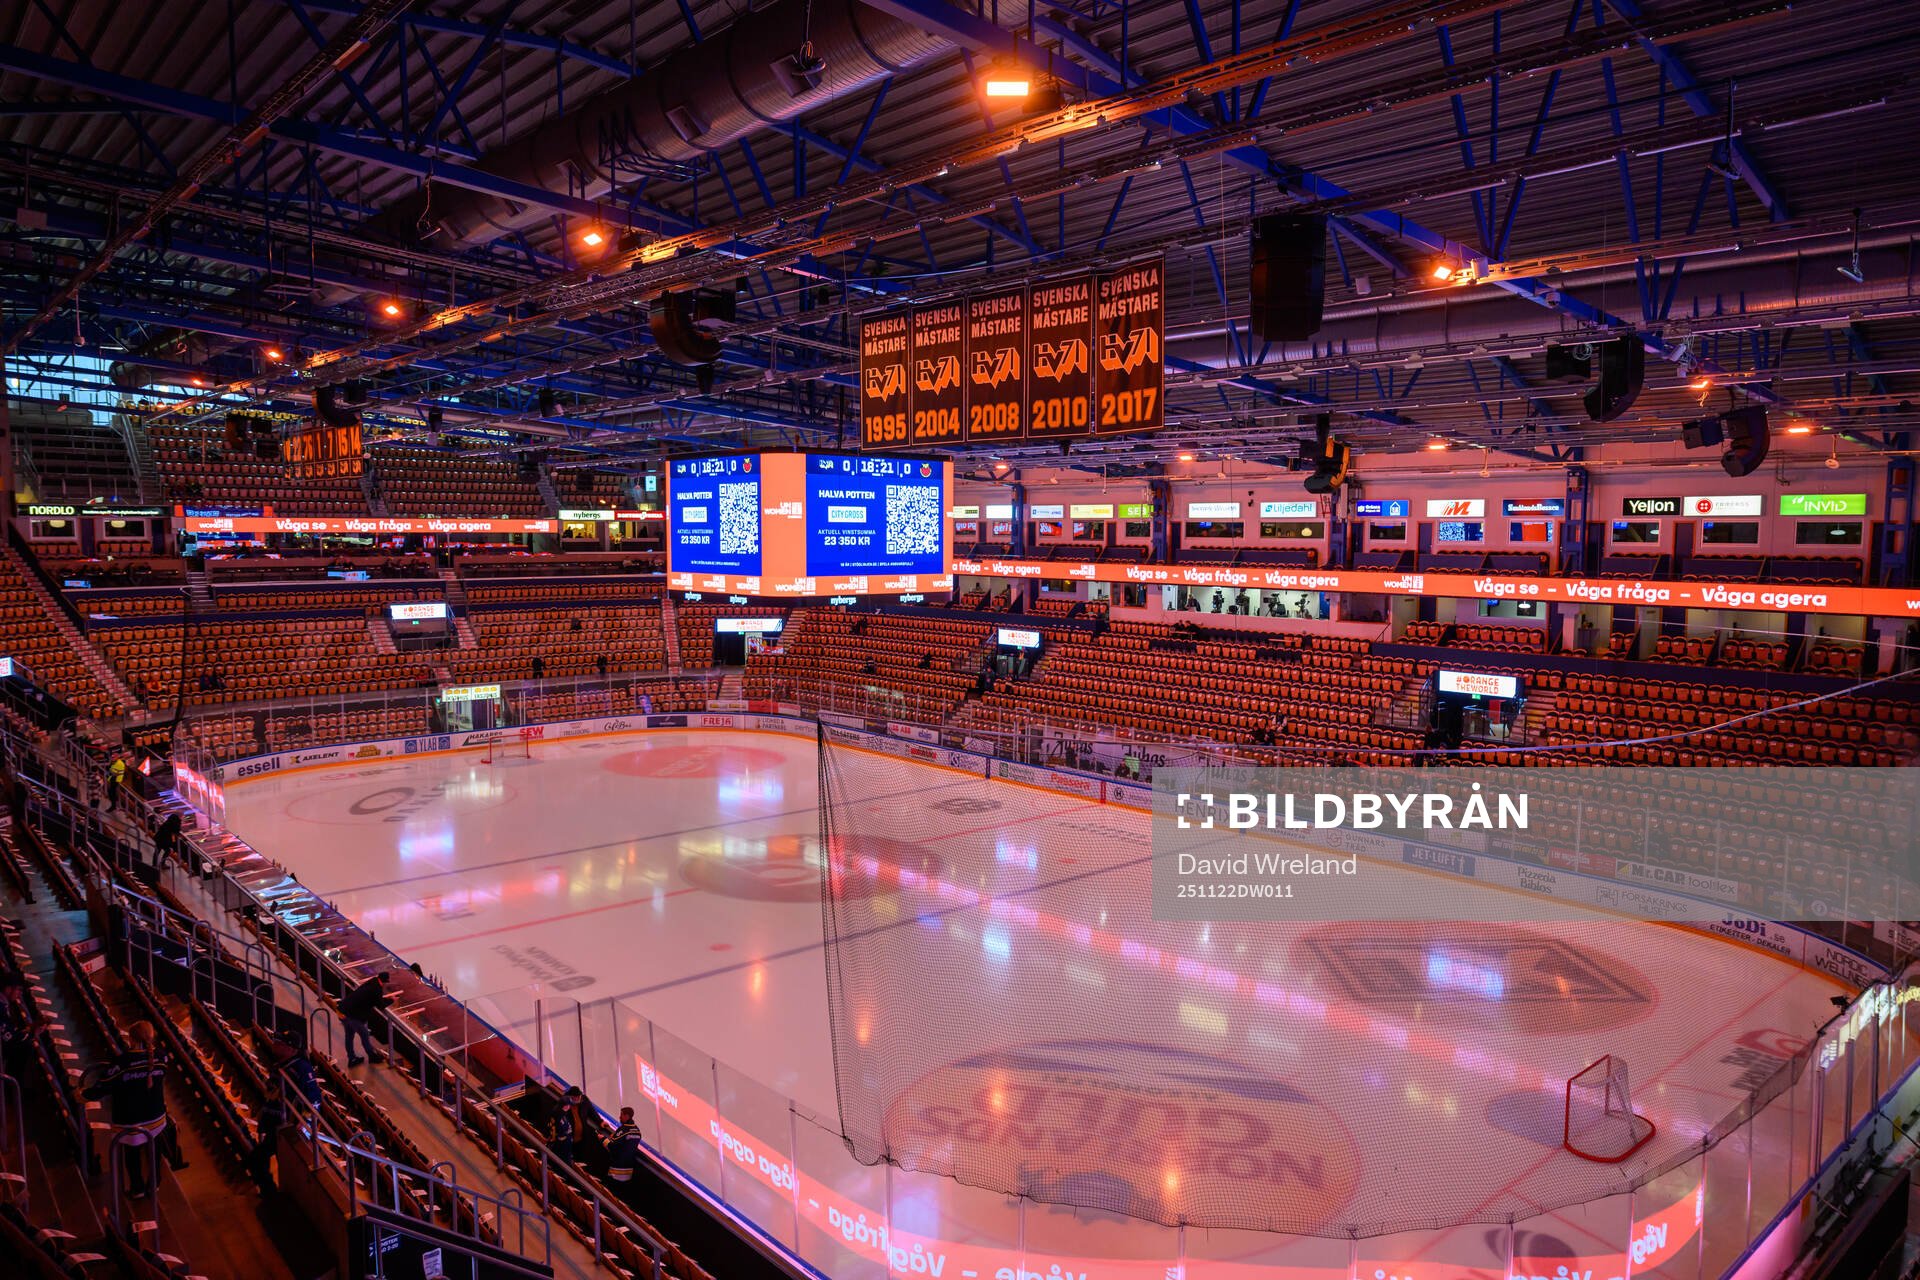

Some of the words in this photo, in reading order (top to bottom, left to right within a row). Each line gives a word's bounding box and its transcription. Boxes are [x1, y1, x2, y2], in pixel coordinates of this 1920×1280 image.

[1100, 269, 1158, 298] SVENSKA
[1033, 284, 1088, 308] SVENSKA
[971, 295, 1021, 318] SVENSKA
[1100, 291, 1158, 320] MÄSTARE
[915, 306, 960, 327] SVENSKA
[1033, 306, 1088, 329] MÄSTARE
[864, 317, 906, 338] SVENSKA
[915, 325, 960, 347] MÄSTARE
[971, 316, 1021, 338] MÄSTARE
[865, 336, 906, 356] MÄSTARE
[1032, 396, 1087, 430] 2010
[1102, 387, 1157, 425] 2017
[866, 413, 906, 442] 1995
[915, 408, 960, 438] 2004
[970, 403, 1020, 434] 2008
[338, 427, 347, 457] 15
[691, 463, 697, 474] 0
[702, 460, 724, 473] 18:21
[731, 459, 737, 471] 0
[843, 460, 850, 472] 0
[861, 460, 894, 474] 18:21
[904, 463, 911, 474] 0
[819, 489, 844, 498] HALVA
[846, 490, 875, 499] POTTEN
[831, 510, 844, 519] CITY
[845, 510, 864, 519] GROSS
[1273, 503, 1313, 515] Liljedahl
[1629, 500, 1675, 514] Yellon
[1804, 501, 1848, 512] INVID
[573, 512, 601, 520] nybergs
[275, 519, 309, 531] Våga
[312, 522, 327, 530] se
[345, 519, 376, 532] Våga
[379, 519, 411, 532] fråga
[428, 519, 457, 532] Våga
[459, 523, 492, 532] agera
[681, 536, 689, 544] 23
[702, 536, 710, 544] KR
[824, 537, 837, 545] 23
[838, 537, 856, 545] 350
[858, 537, 871, 545] KR
[959, 561, 981, 573] fråga
[992, 561, 1014, 575] Våga
[1015, 565, 1041, 576] agera
[1126, 566, 1153, 581] Våga
[1155, 571, 1168, 579] se
[1183, 568, 1212, 583] Våga
[1215, 569, 1247, 584] fråga
[1265, 570, 1297, 587] Våga
[1299, 576, 1339, 588] agera
[830, 596, 857, 605] nybergs
[899, 594, 924, 603] nybergs
[1473, 577, 1515, 596] Våga
[1519, 583, 1539, 594] se
[1565, 580, 1612, 600] Våga
[1617, 582, 1670, 602] fråga
[1701, 585, 1755, 606] Våga
[1760, 591, 1828, 609] agera
[703, 717, 731, 725] FREJA
[520, 726, 544, 737] SEW
[302, 752, 340, 761] AXELENT
[238, 757, 280, 776] essell
[1517, 866, 1556, 884] Pizzeria
[1520, 877, 1552, 895] Biblos
[1638, 903, 1669, 917] HUSET
[1756, 937, 1791, 955] DEKALER
[1826, 947, 1868, 977] NORDIC
